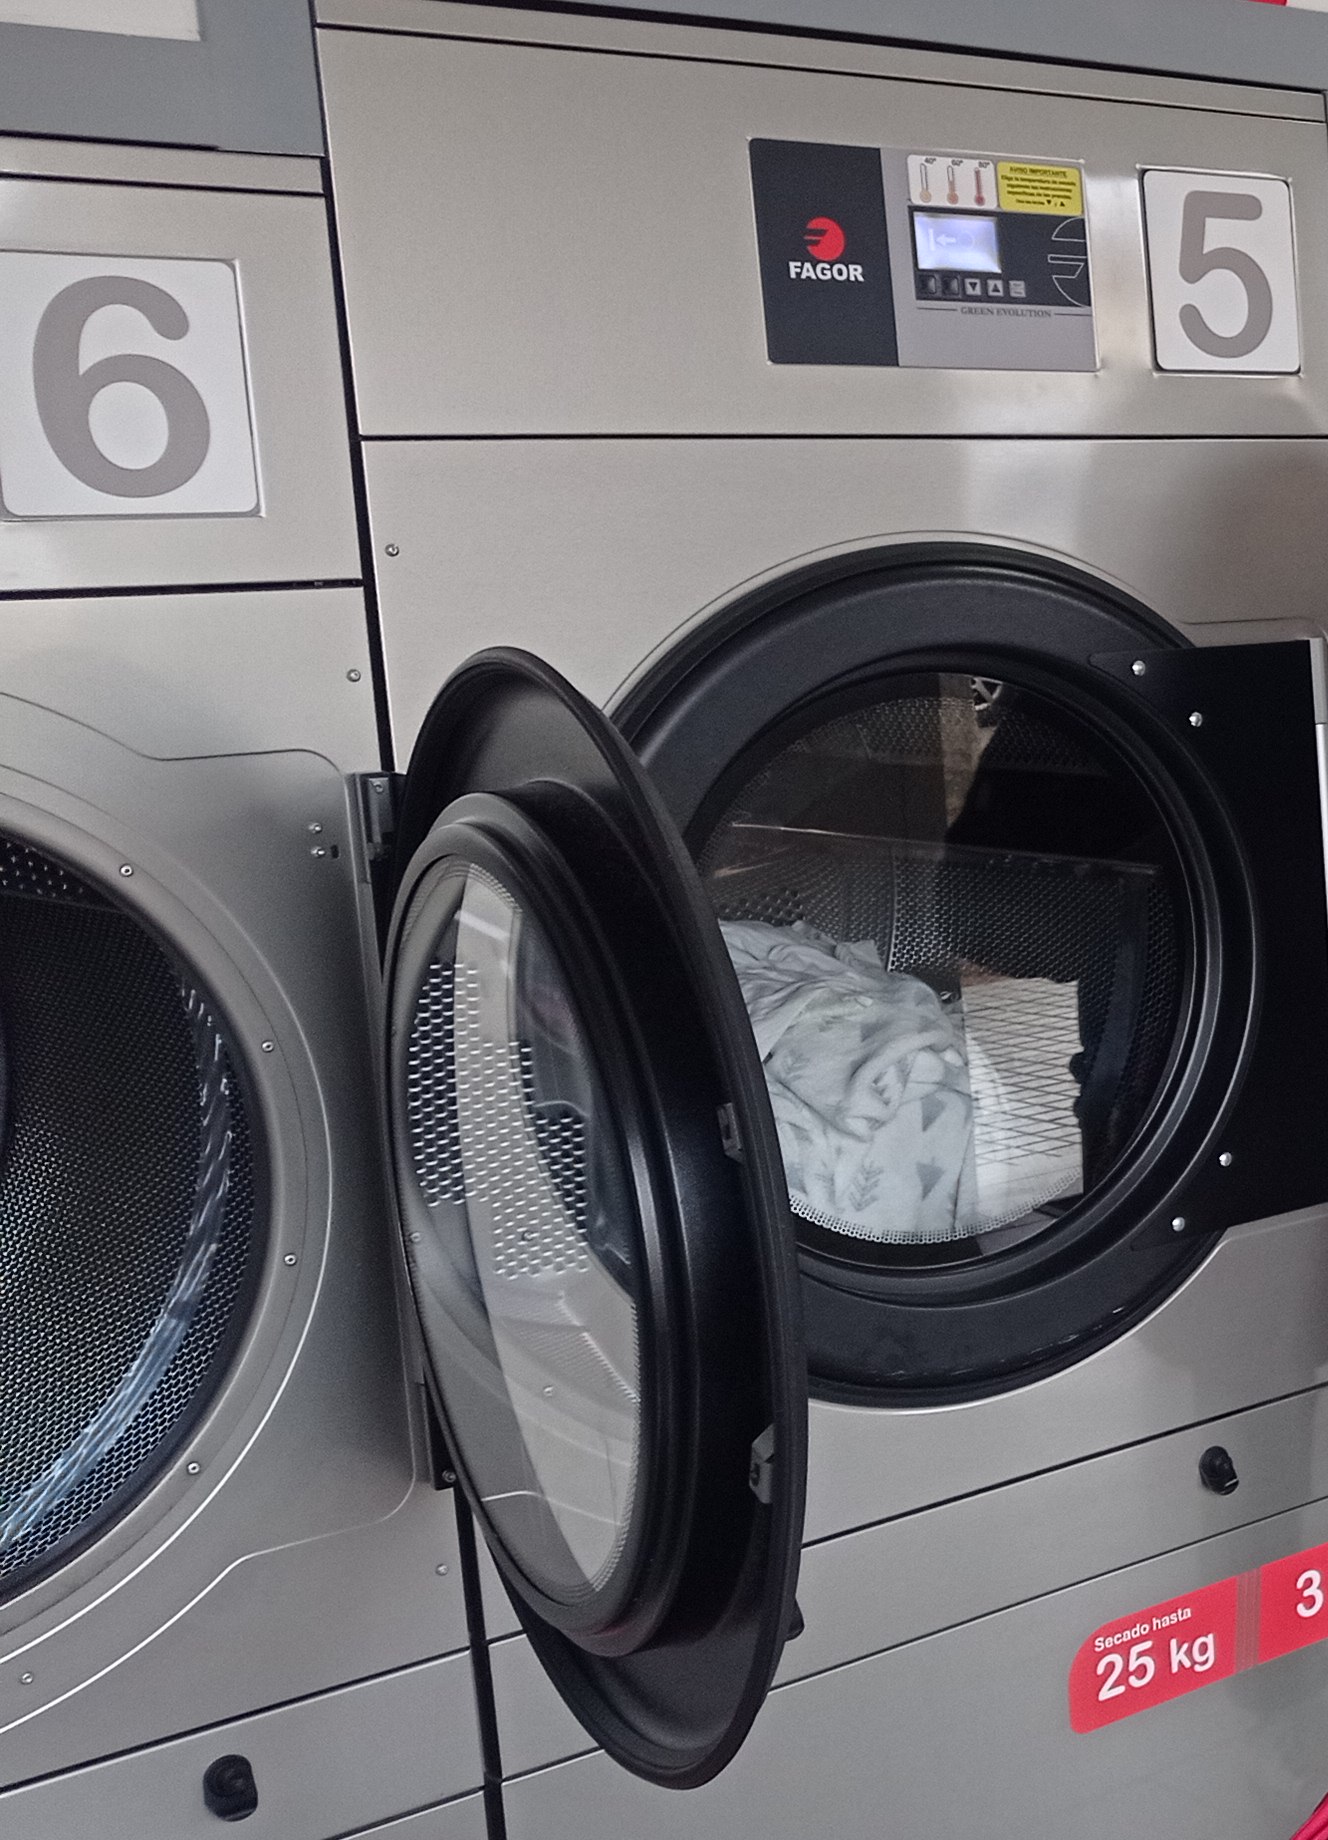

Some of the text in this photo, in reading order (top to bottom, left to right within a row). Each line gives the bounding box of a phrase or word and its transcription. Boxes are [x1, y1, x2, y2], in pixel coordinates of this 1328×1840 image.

[789, 261, 864, 282] FAGOR
[1178, 190, 1273, 358] 5
[997, 309, 1052, 318] EVOLUTION
[33, 274, 211, 498] 6
[1094, 1606, 1192, 1651] Secado hasta
[1096, 1633, 1215, 1701] 25 kg
